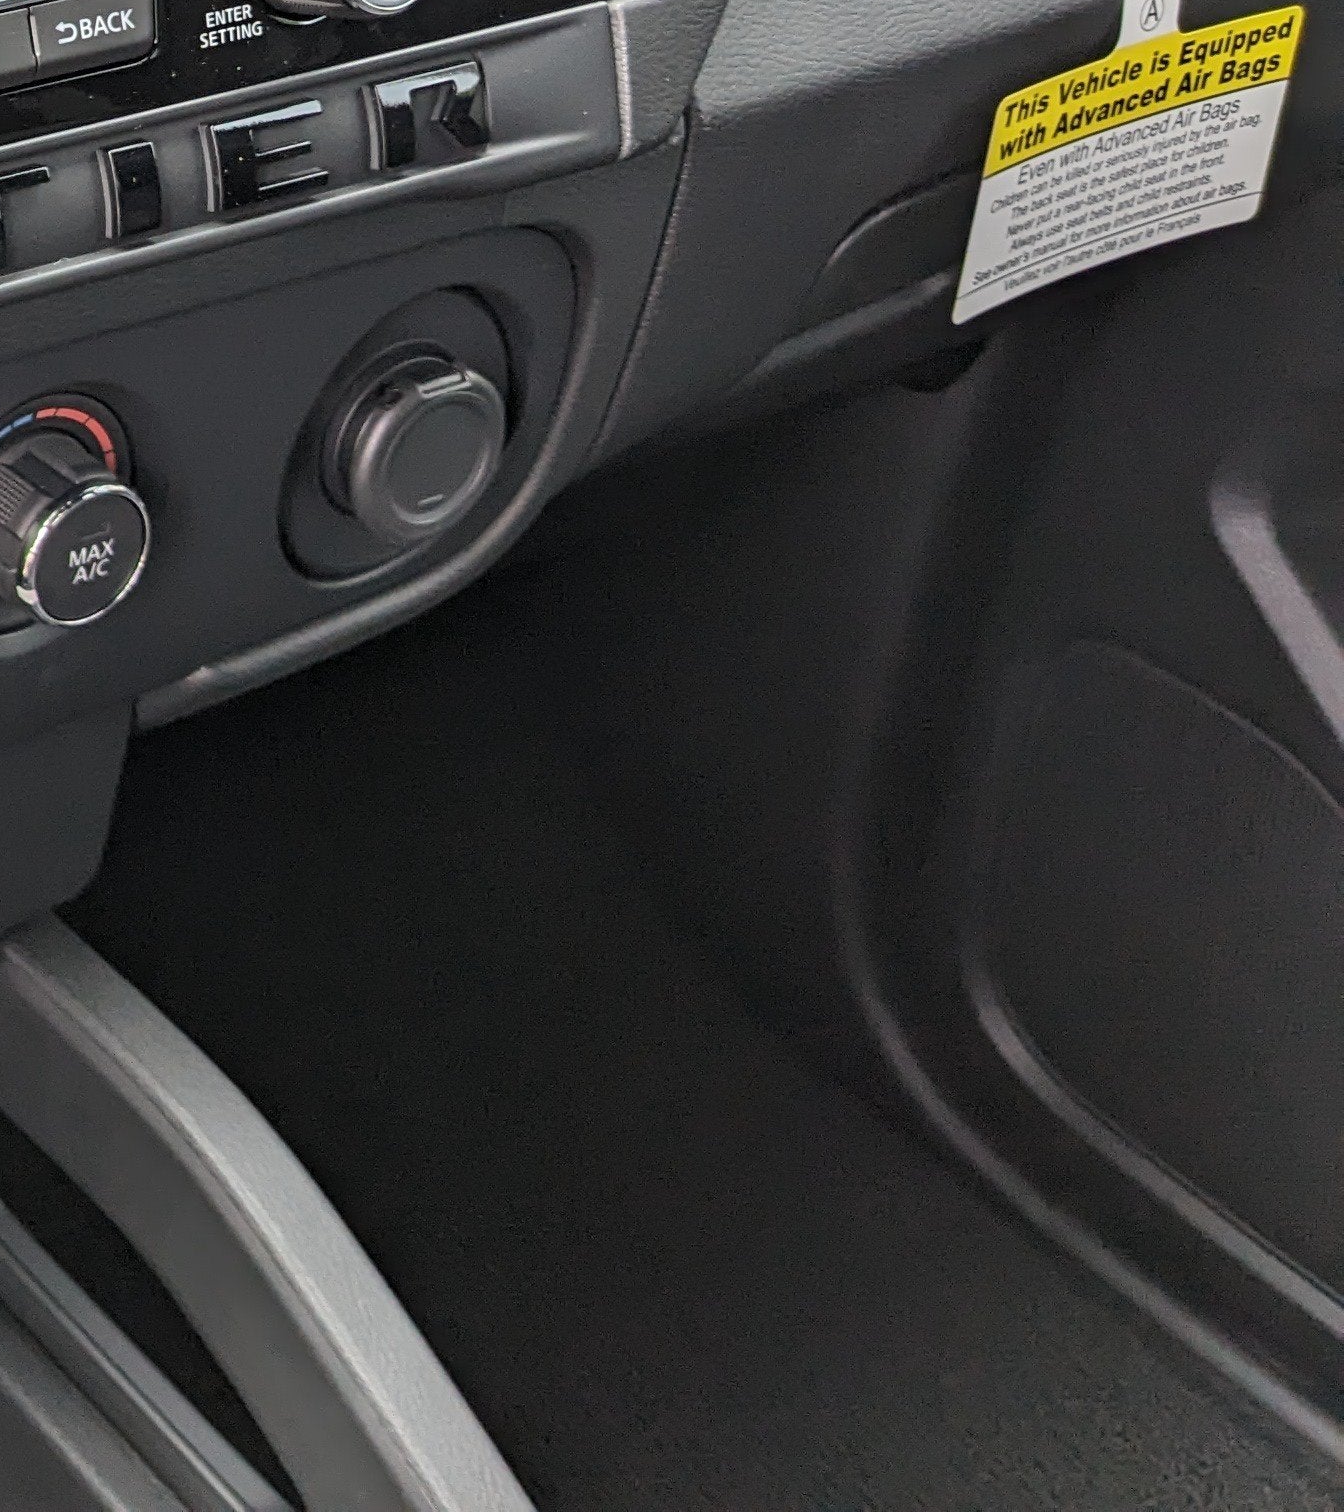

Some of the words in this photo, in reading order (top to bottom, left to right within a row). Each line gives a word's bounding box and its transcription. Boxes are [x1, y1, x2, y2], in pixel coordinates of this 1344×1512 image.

[79, 9, 136, 40] BACK
[206, 4, 253, 28] ENTER
[199, 20, 263, 50] SETTING
[1005, 93, 1050, 127] This
[1059, 61, 1143, 105] Vehicle
[1150, 51, 1171, 74] is
[1178, 16, 1294, 66] Equipped
[1000, 123, 1047, 160] with
[1053, 79, 1170, 137] Advanced
[1175, 69, 1213, 97] Air
[1219, 54, 1281, 84] Bags
[1017, 158, 1055, 185] Even
[1059, 143, 1090, 168] with
[1092, 115, 1171, 156] Advanced
[1171, 109, 1197, 131] Air
[1199, 99, 1241, 123] Bags
[69, 537, 115, 568] MAX
[72, 558, 110, 585] A/C
